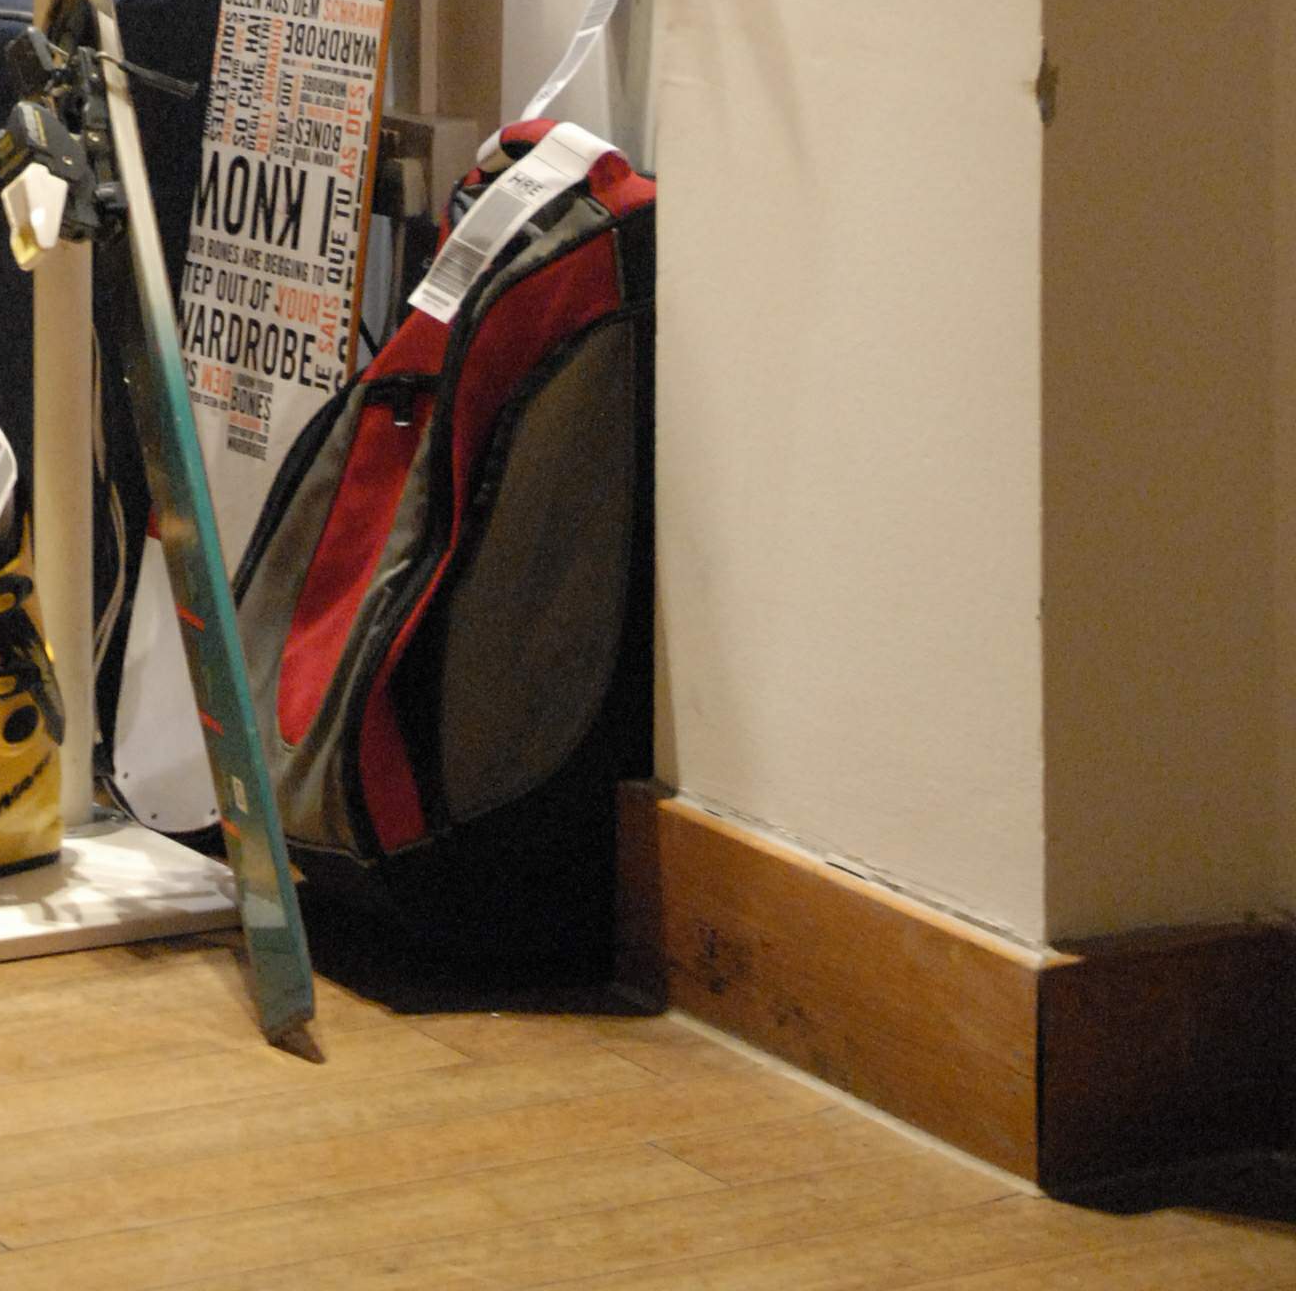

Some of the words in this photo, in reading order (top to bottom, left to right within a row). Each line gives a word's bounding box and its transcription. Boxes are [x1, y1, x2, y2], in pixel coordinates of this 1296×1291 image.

[244, 15, 262, 53] HAI
[237, 64, 255, 108] CHE
[280, 72, 294, 107] OUT
[232, 117, 249, 146] SO
[295, 117, 342, 152] BONES
[339, 146, 358, 179] AS
[507, 171, 545, 198] HRE
[334, 187, 353, 218] TU
[326, 230, 348, 284] QUE
[216, 269, 248, 306] OUT
[249, 278, 273, 313] OF
[274, 282, 322, 325] YOUR
[317, 293, 341, 355] SAIS
[314, 364, 332, 395] JE
